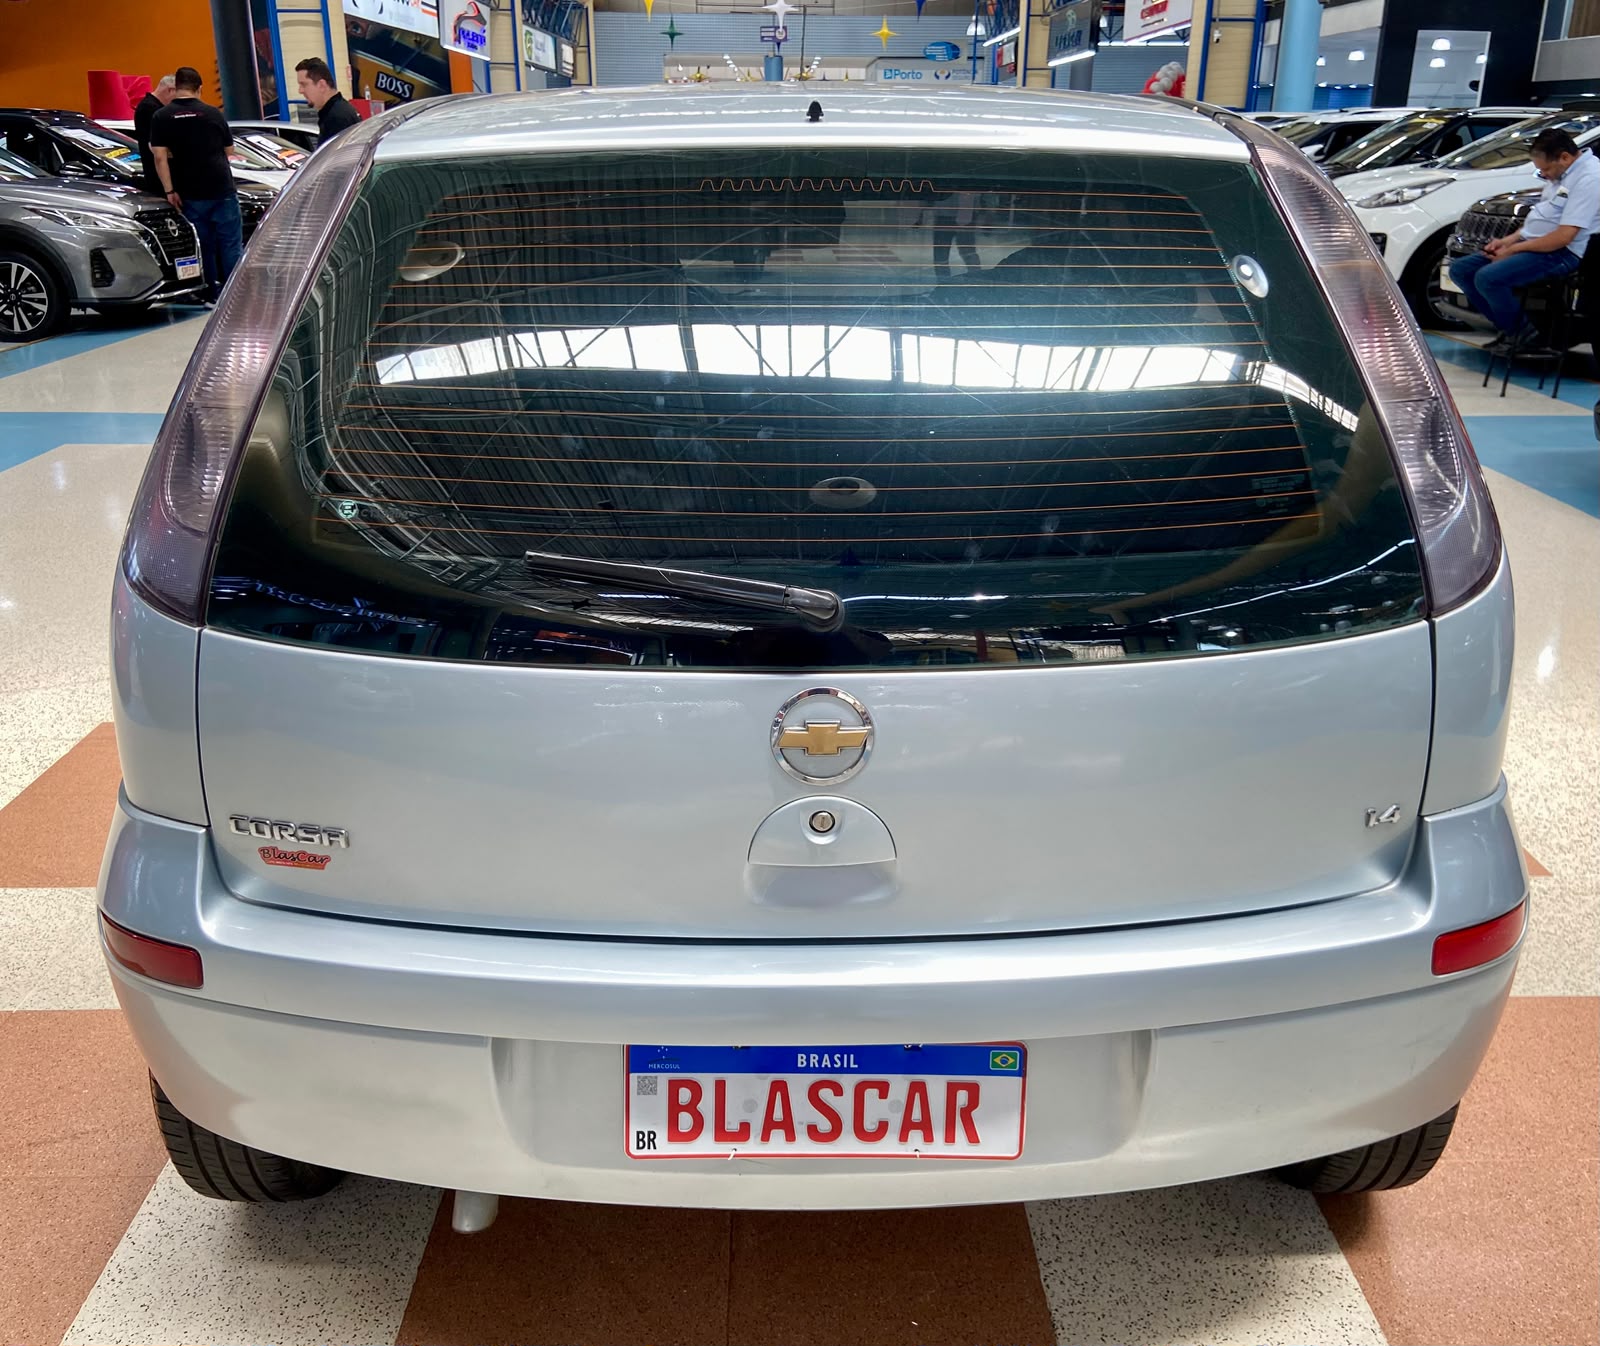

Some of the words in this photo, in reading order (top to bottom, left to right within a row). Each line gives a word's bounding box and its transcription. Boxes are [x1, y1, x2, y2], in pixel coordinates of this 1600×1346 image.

[894, 69, 922, 79] Porto
[377, 73, 411, 98] BOSS
[229, 814, 350, 849] CORSA
[260, 847, 329, 864] BlasCar
[797, 1053, 858, 1068] BRASIL
[667, 1079, 981, 1144] BLASCAR
[636, 1131, 657, 1150] BR
